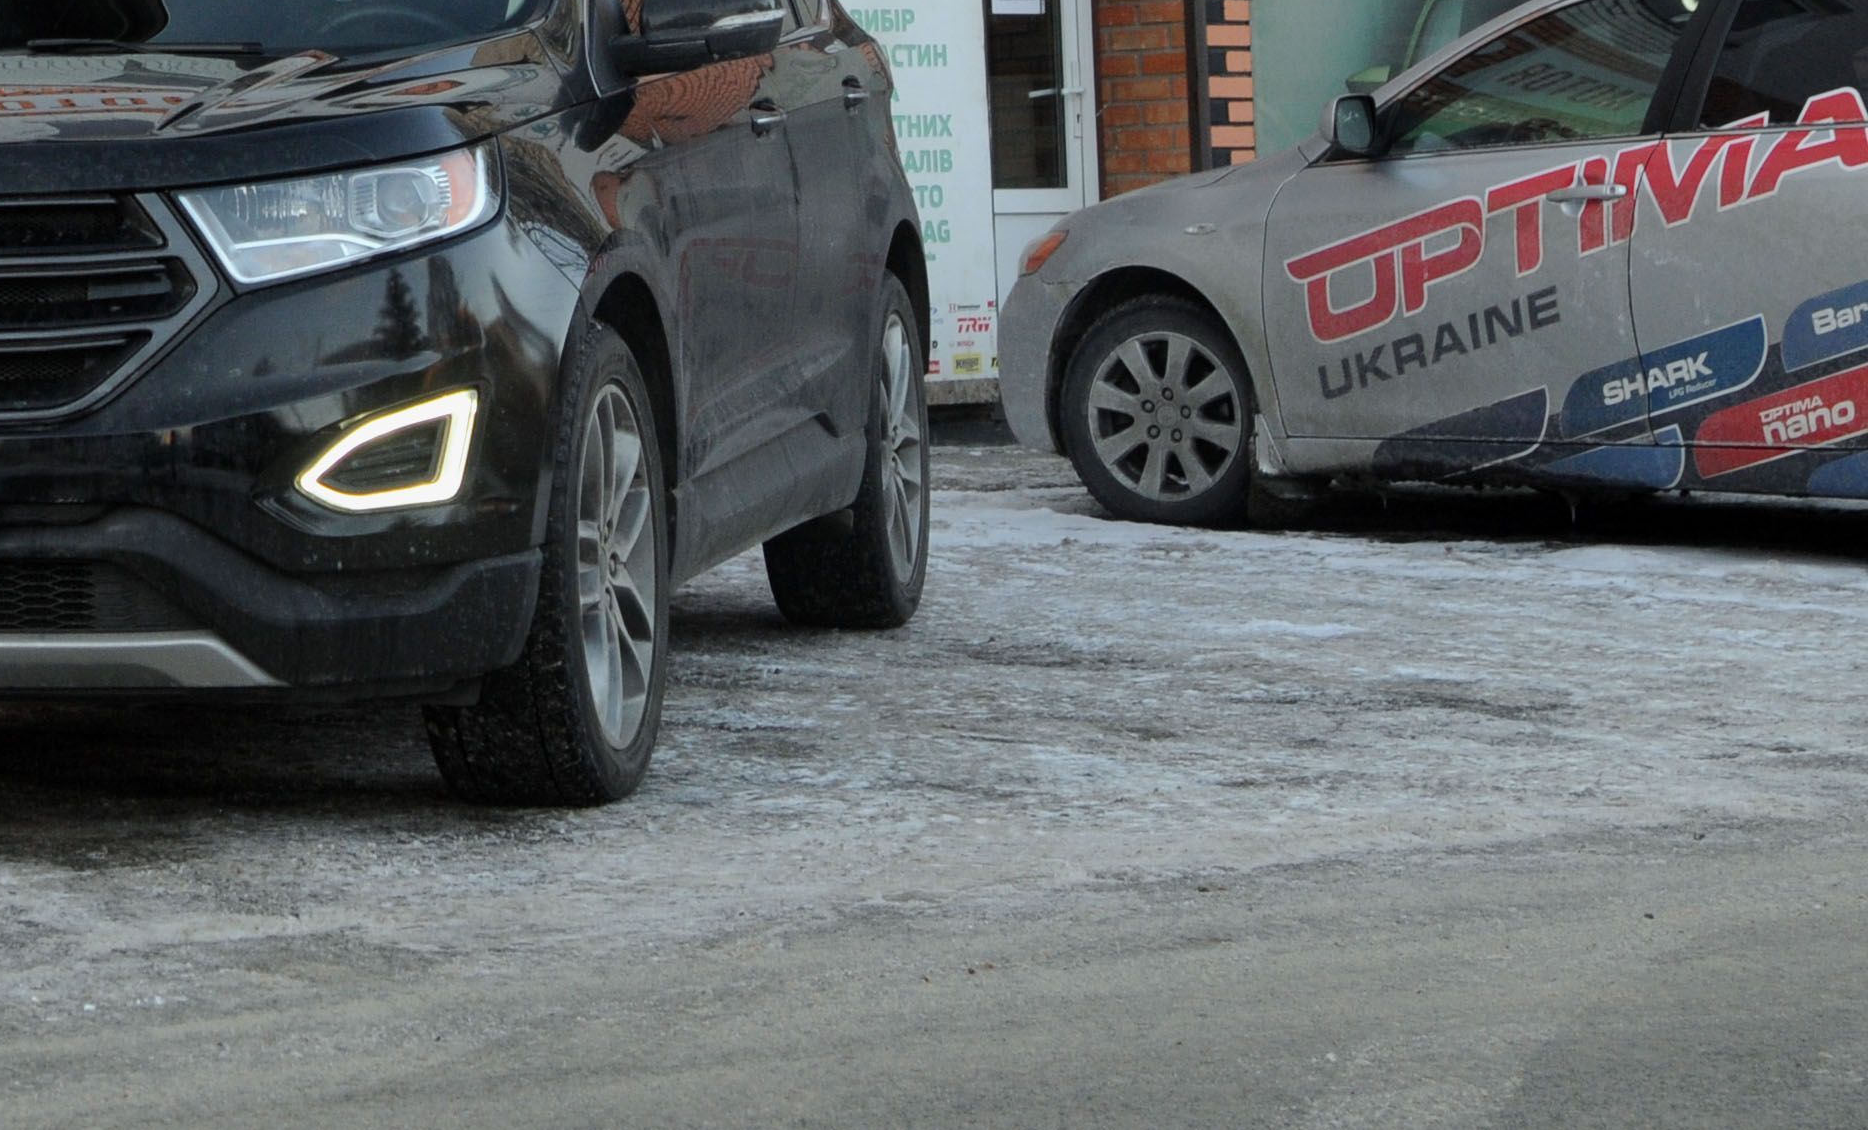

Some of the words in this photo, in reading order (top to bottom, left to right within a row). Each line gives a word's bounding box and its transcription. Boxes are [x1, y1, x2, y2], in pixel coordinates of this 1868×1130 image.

[883, 44, 948, 68] СТИН
[892, 114, 953, 137] ТНИХ
[899, 148, 953, 173] АЛІВ
[1285, 86, 1868, 344] OPTIMA
[1318, 285, 1561, 400] UKRAINE
[1603, 351, 1713, 406] SHARK
[1759, 395, 1823, 422] OPTIMA
[1763, 400, 1855, 446] nano
